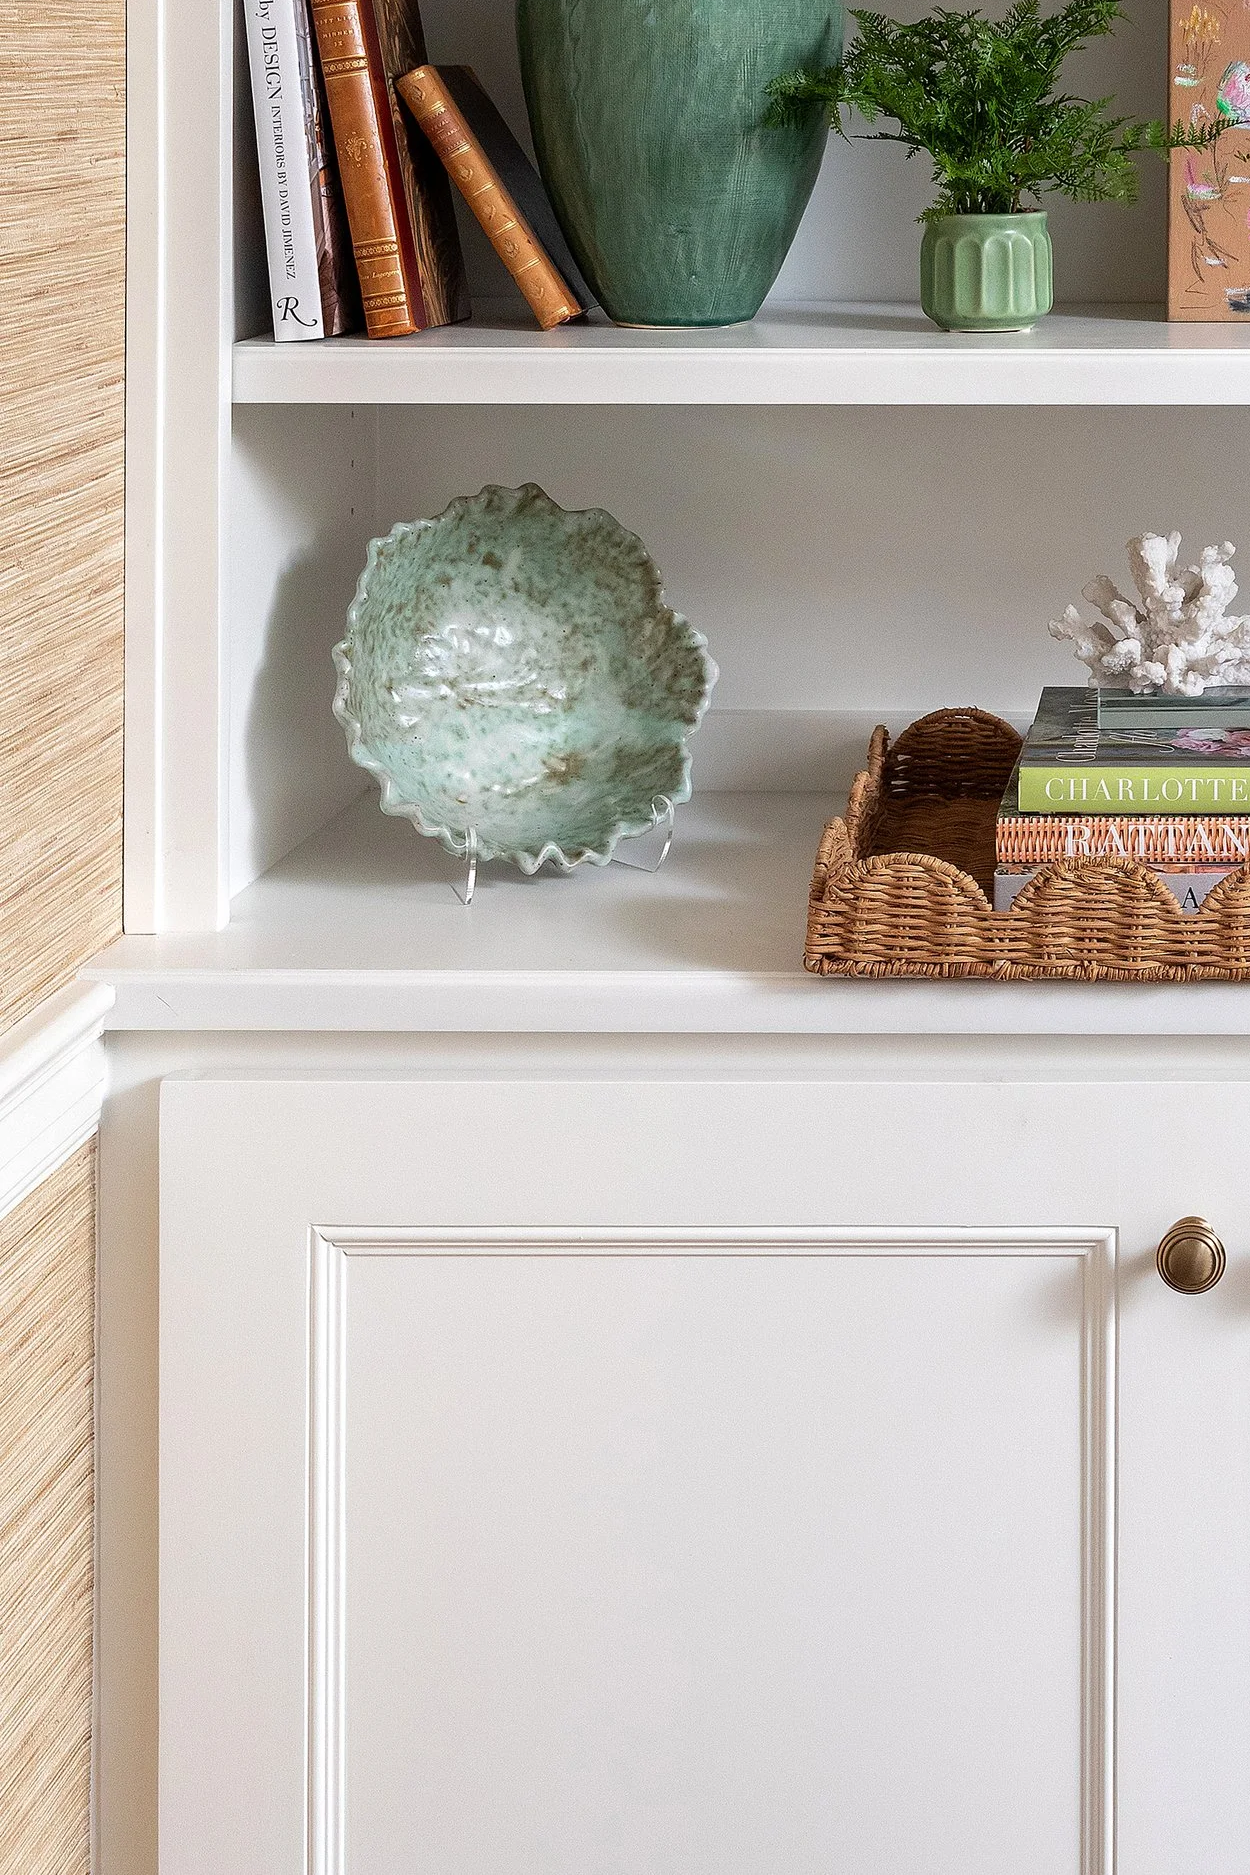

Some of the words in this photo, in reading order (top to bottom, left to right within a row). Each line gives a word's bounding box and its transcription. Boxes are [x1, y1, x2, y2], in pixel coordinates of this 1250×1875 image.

[261, 26, 283, 100] DESIGN
[271, 105, 286, 169] INTERIORS
[277, 170, 289, 191] BY
[279, 191, 291, 226] DAVID
[281, 228, 296, 280] JIMENEZ
[1045, 777, 1248, 802] CHARLOTTE
[1064, 824, 1250, 858] RATTAN
